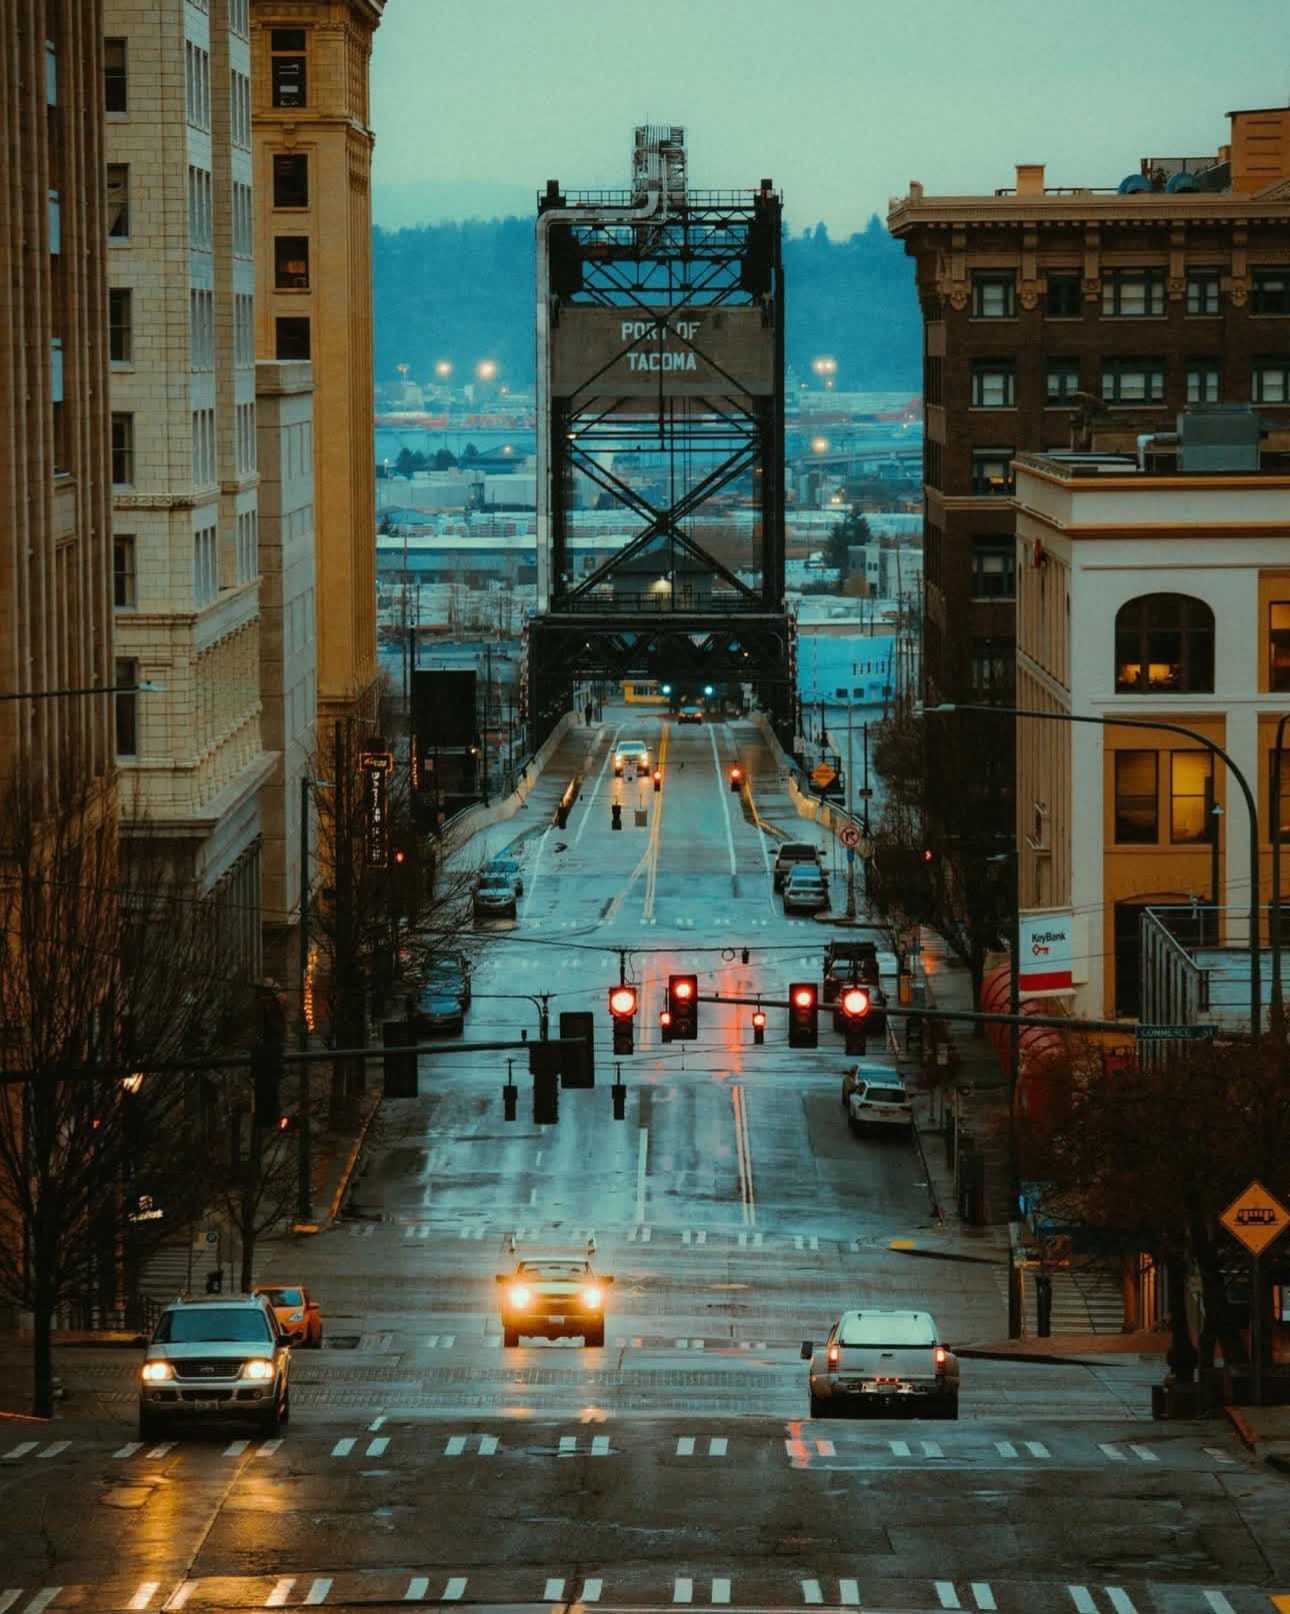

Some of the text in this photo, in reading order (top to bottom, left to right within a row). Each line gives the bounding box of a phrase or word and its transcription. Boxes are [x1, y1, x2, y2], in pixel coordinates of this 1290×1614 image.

[676, 321, 701, 340] OF
[626, 352, 697, 371] TACOMA
[1032, 931, 1066, 944] KeyBank
